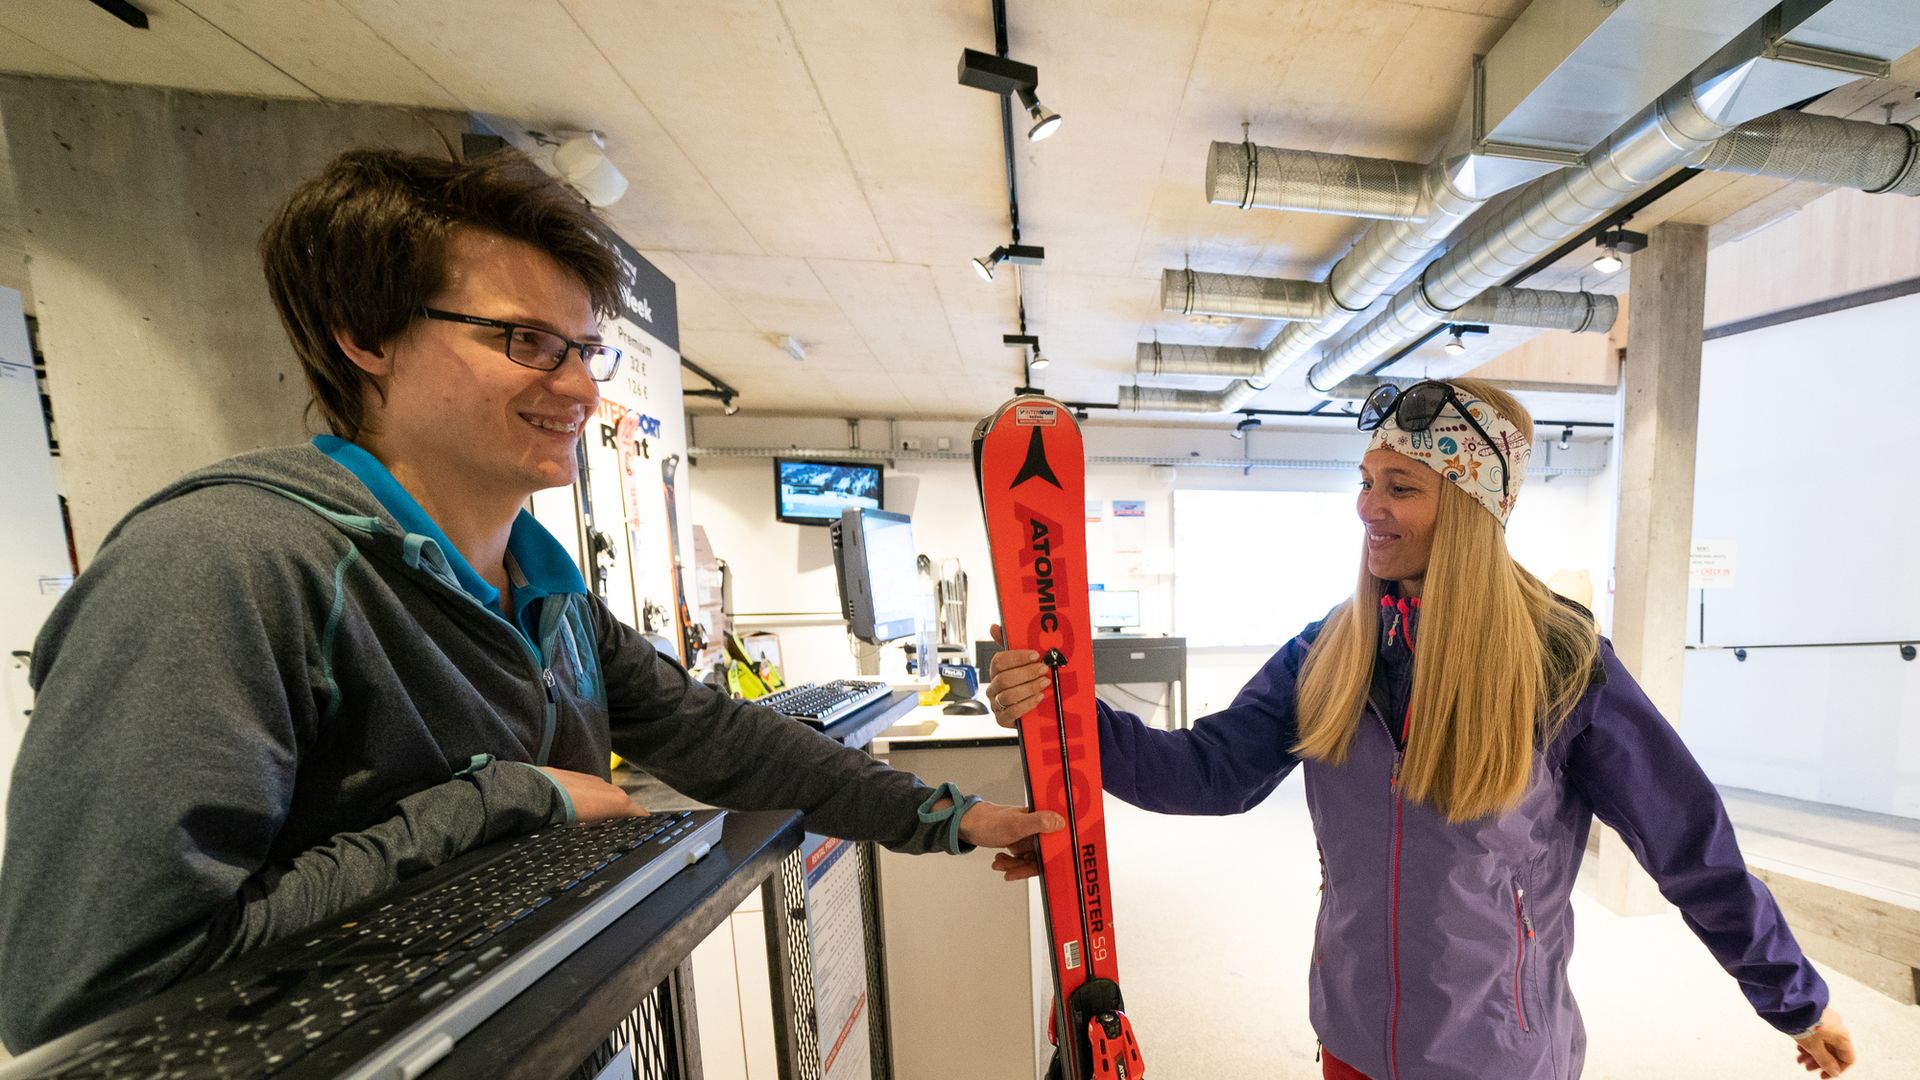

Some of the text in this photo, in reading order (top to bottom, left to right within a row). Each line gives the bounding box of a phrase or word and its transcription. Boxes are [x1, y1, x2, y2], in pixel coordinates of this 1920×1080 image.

[618, 325, 652, 358] Premium
[630, 355, 640, 373] 32
[600, 423, 650, 460] Rnt
[1030, 517, 1059, 634] ATOMIC
[1082, 843, 1108, 962] REDSTER S9
[1118, 1064, 1126, 1080] ATO
